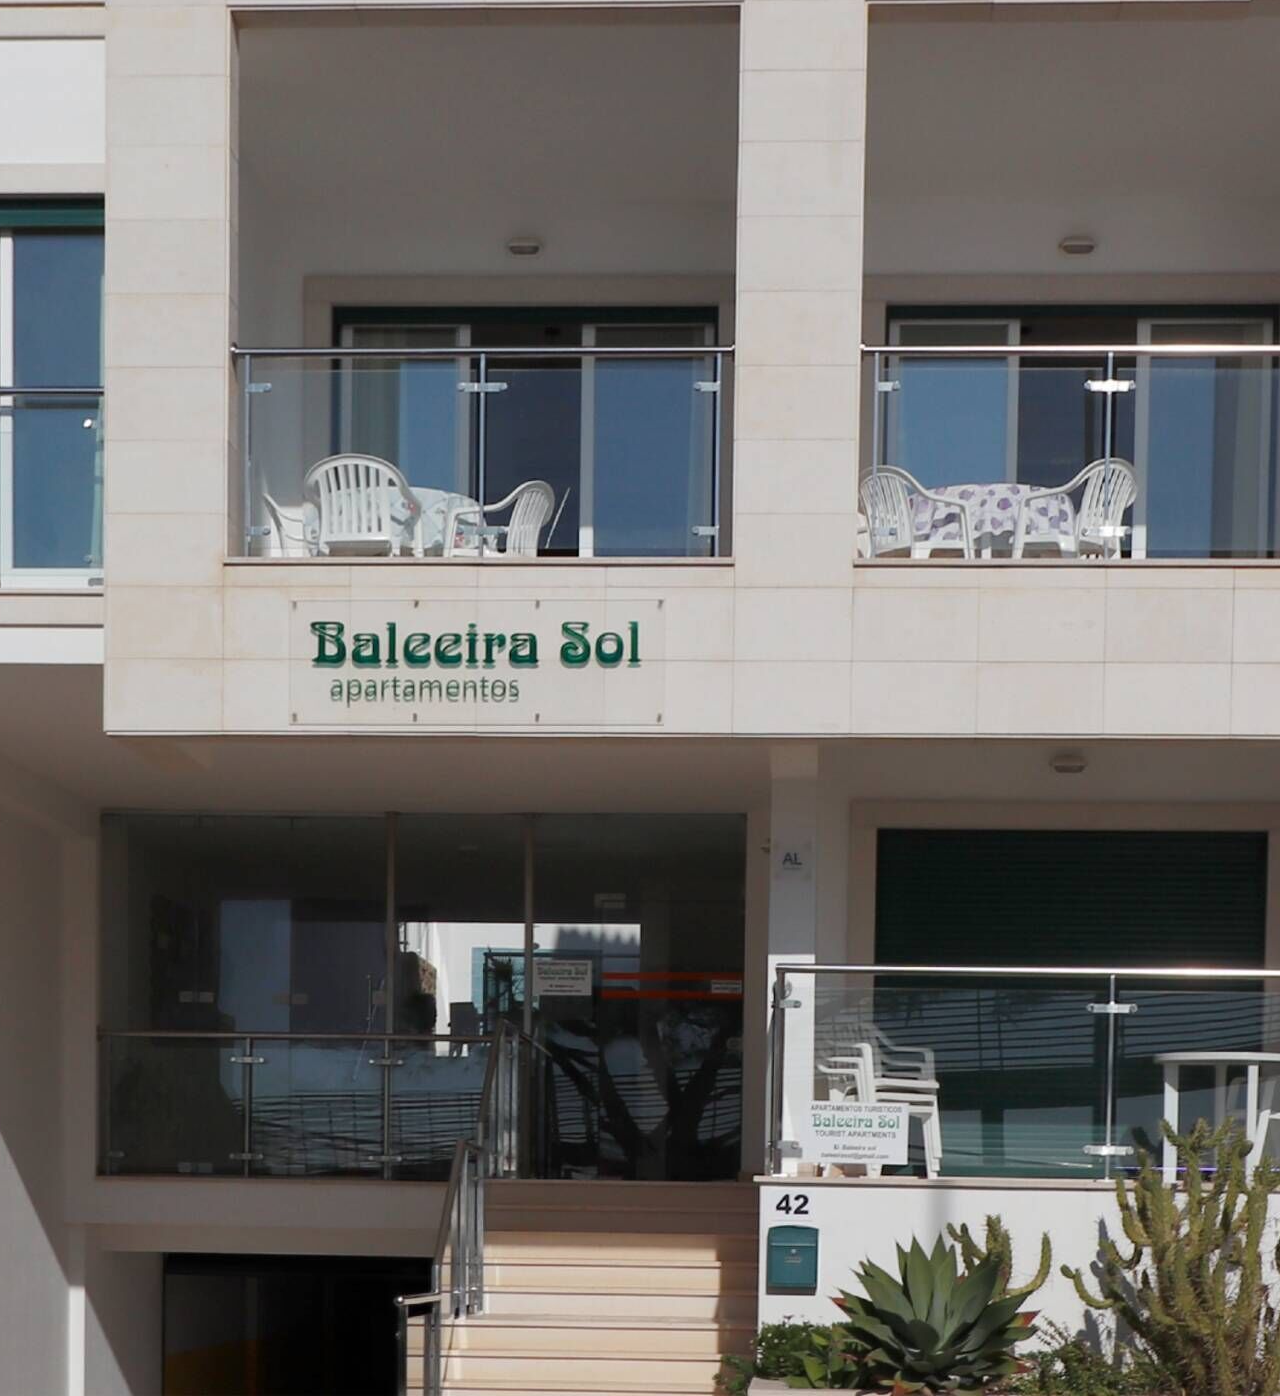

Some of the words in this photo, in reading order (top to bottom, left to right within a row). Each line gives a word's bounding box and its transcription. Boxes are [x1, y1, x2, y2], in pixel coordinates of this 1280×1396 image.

[310, 621, 539, 666] Baleeira
[560, 621, 642, 666] Sol
[330, 675, 520, 708] apartamentos
[782, 852, 802, 865] AL
[810, 1104, 862, 1113] APARTAMENTOS
[812, 1113, 873, 1128] Baleeira
[878, 1115, 900, 1129] Sol
[815, 1130, 846, 1138] TOURIST
[847, 1130, 896, 1139] APARTMENTS
[776, 1194, 809, 1215] 42
